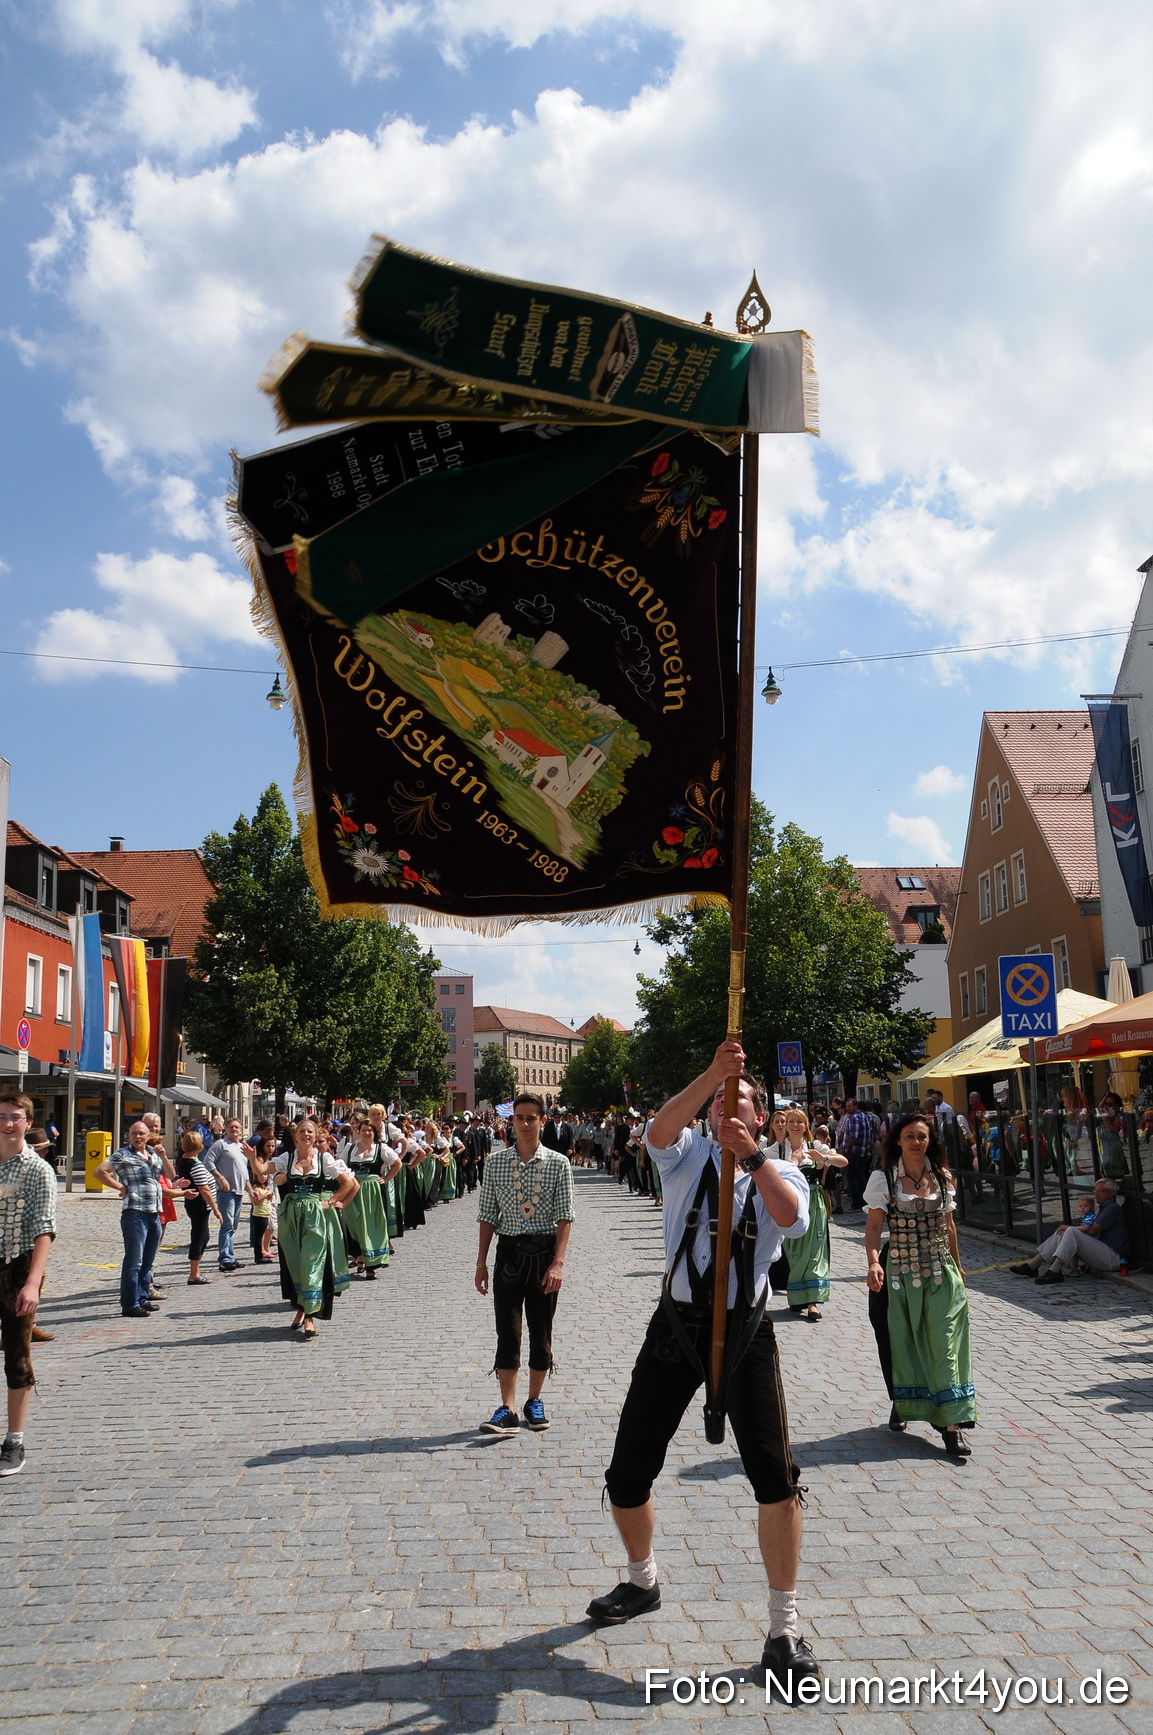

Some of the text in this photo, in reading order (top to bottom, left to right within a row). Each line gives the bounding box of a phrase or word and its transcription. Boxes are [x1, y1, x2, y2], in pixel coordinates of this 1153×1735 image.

[549, 319, 571, 369] von den
[567, 315, 593, 382] gewidmet
[634, 337, 678, 396] Dank
[664, 342, 708, 405] Paten
[408, 428, 428, 452] zur
[434, 419, 465, 471] en Tot
[326, 470, 347, 499] 1988
[369, 453, 391, 487] Stadt
[333, 634, 489, 805] Wolfstein
[1104, 781, 1139, 850] K&L
[1006, 1012, 1052, 1032] TAXI
[781, 1065, 801, 1075] TAXI
